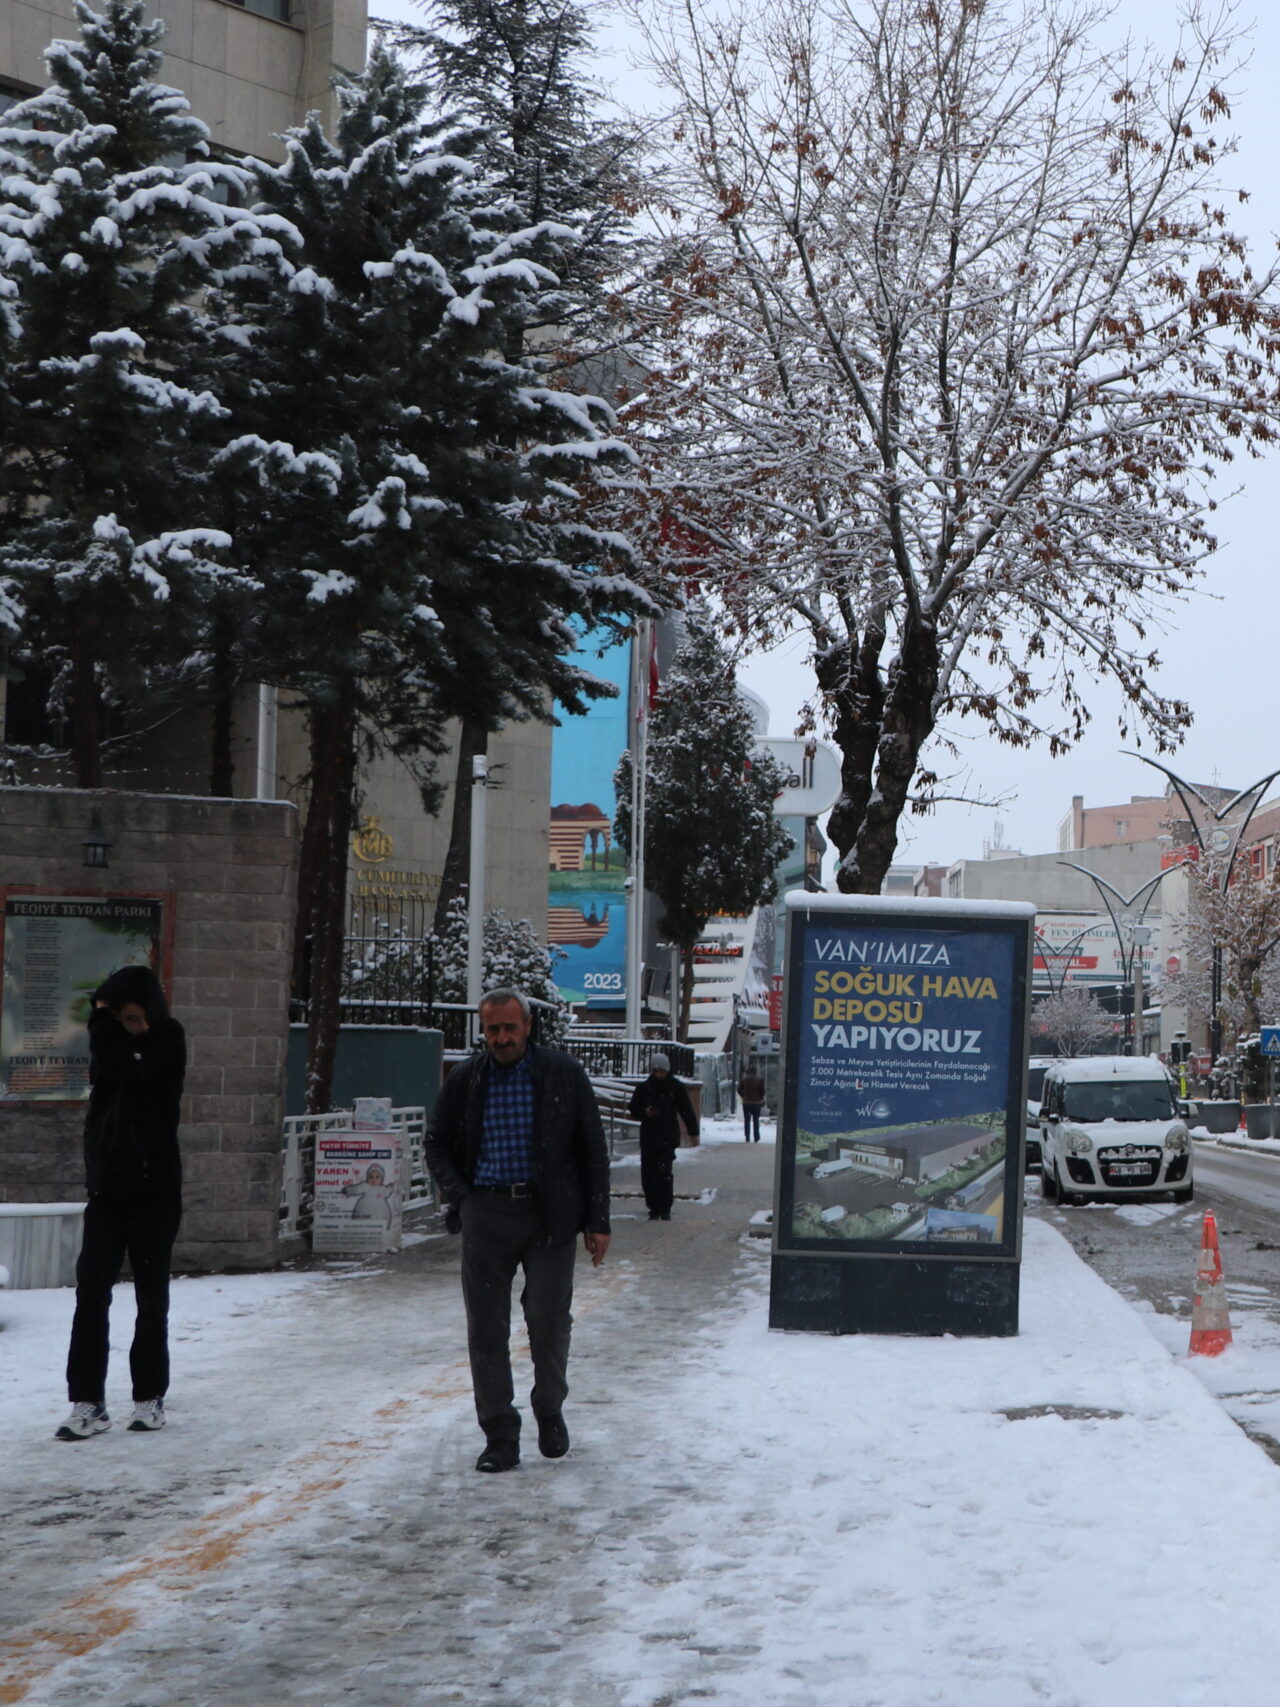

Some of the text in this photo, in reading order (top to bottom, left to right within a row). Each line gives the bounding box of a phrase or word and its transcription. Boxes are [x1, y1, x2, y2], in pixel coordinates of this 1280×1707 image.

[61, 904, 111, 916] TEYRAN
[584, 972, 622, 990] 2023
[813, 966, 998, 999] SOĞUK HAVA
[813, 998, 924, 1024] DEPOSU
[811, 1024, 983, 1053] YAPIYORUZ
[49, 1056, 89, 1066] TEYRAN
[811, 1056, 835, 1065] Sebze
[849, 1057, 874, 1067] Meyve
[811, 1067, 987, 1082] 5.000 Metrekarelik Tesis Aynı Zamanda Soğuk
[810, 1078, 831, 1087] Zincir
[871, 1080, 898, 1089] Hizmet
[900, 1081, 930, 1090] Verecek
